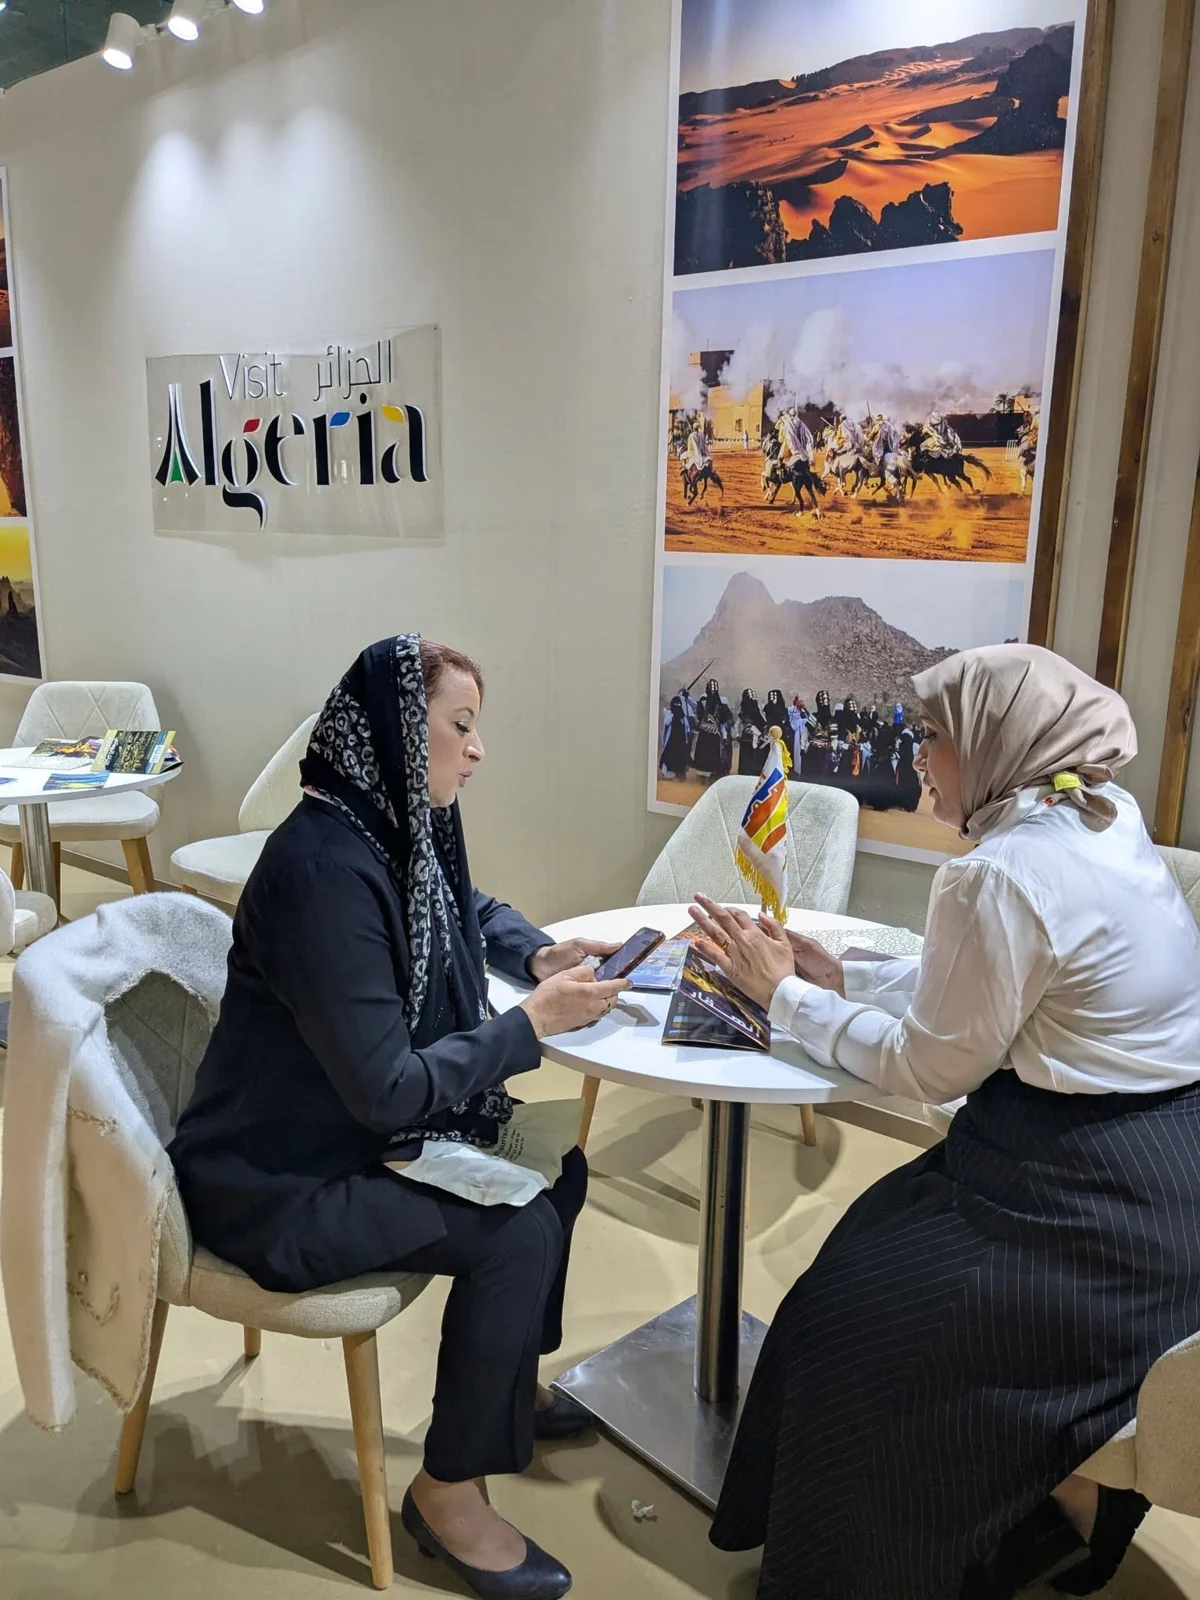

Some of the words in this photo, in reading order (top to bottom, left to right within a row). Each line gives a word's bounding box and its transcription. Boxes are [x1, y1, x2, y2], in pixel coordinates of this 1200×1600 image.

[219, 353, 284, 400] Visit
[313, 340, 392, 401] الجزائر
[155, 379, 429, 530] Algeria
